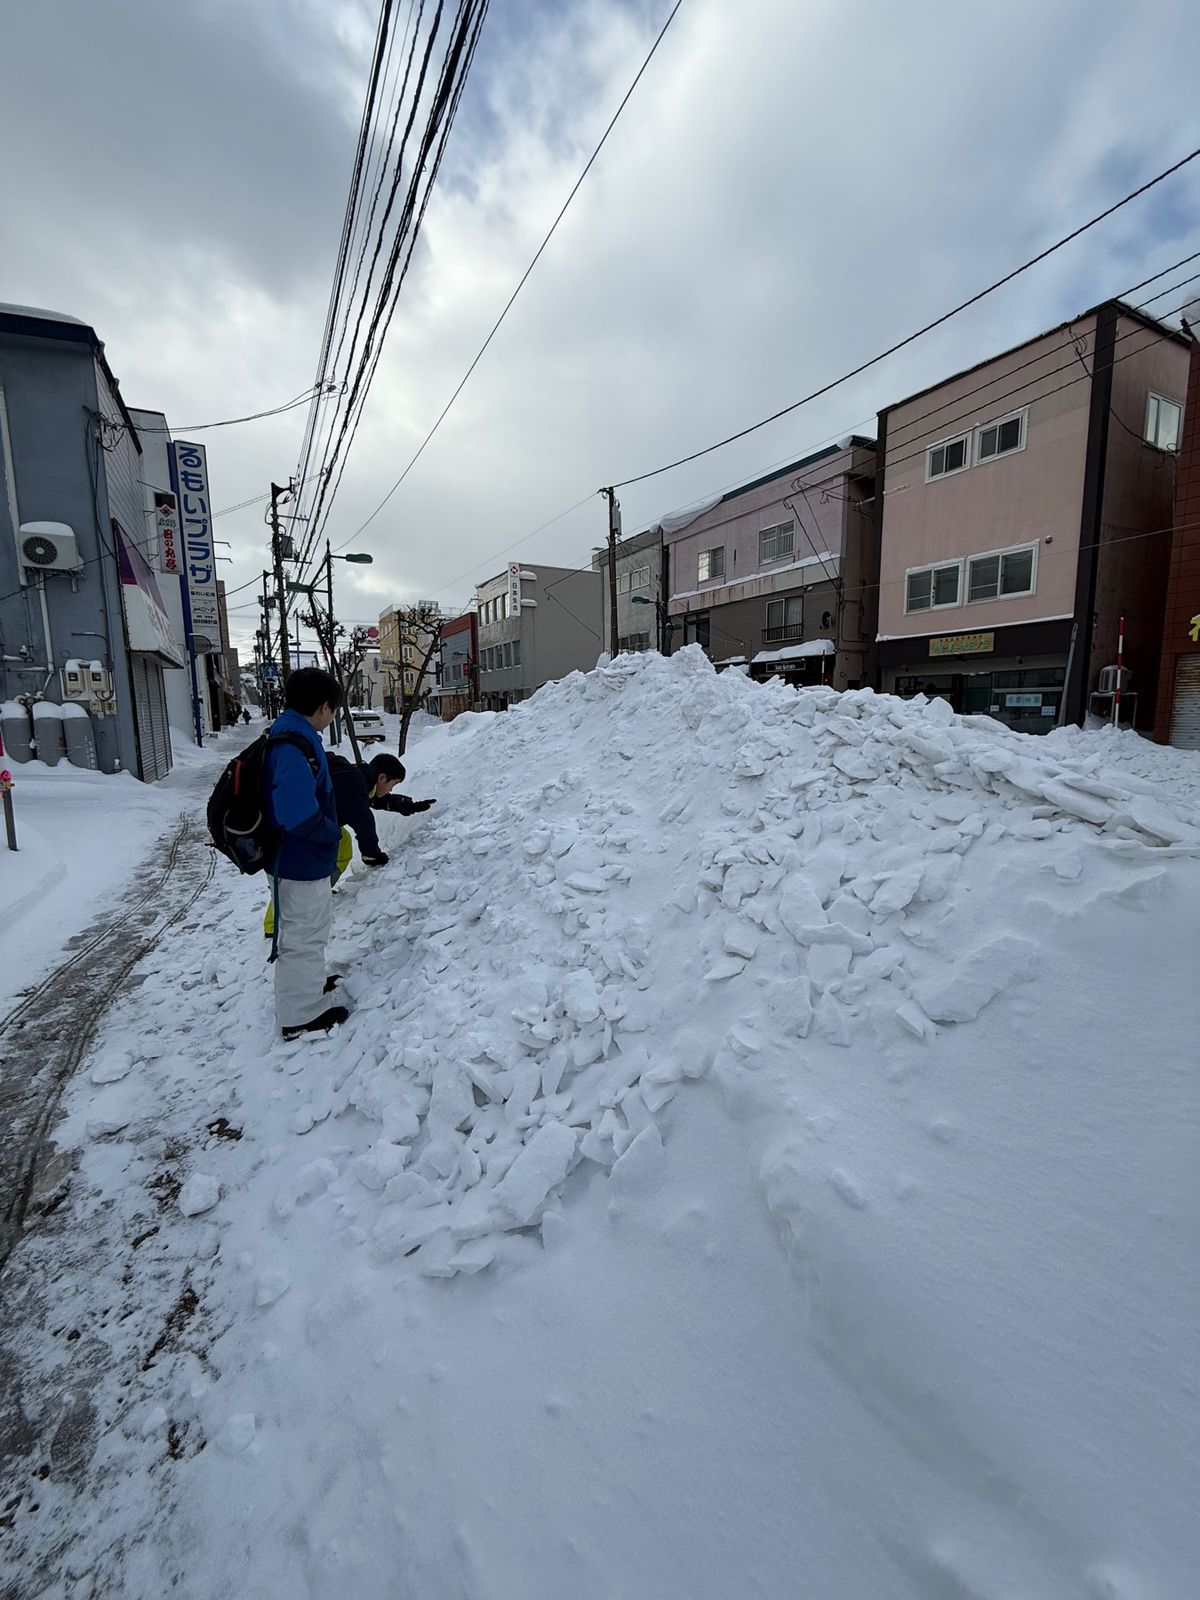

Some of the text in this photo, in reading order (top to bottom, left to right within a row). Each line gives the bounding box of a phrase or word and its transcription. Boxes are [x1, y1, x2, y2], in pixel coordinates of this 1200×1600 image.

[179, 446, 213, 584] るもいプラザ
